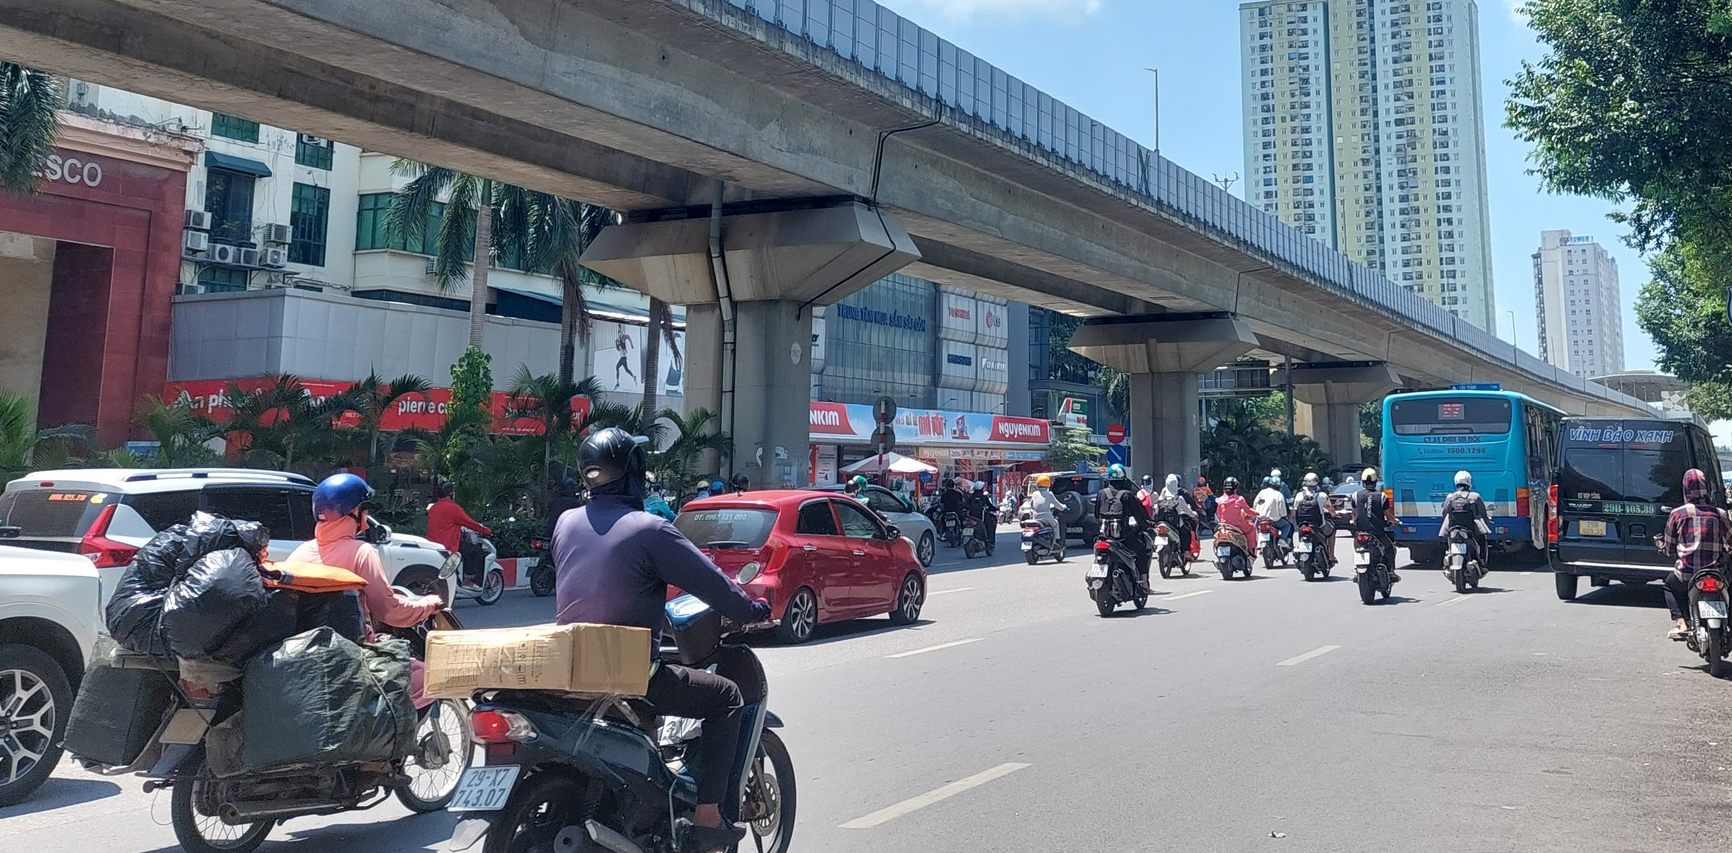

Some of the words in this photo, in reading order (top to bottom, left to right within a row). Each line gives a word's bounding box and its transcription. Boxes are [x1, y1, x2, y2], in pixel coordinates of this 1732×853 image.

[33, 154, 102, 187] SCO
[1635, 430, 1674, 443] XANH
[466, 768, 511, 788] 29-X7
[453, 787, 507, 807] 743.07
